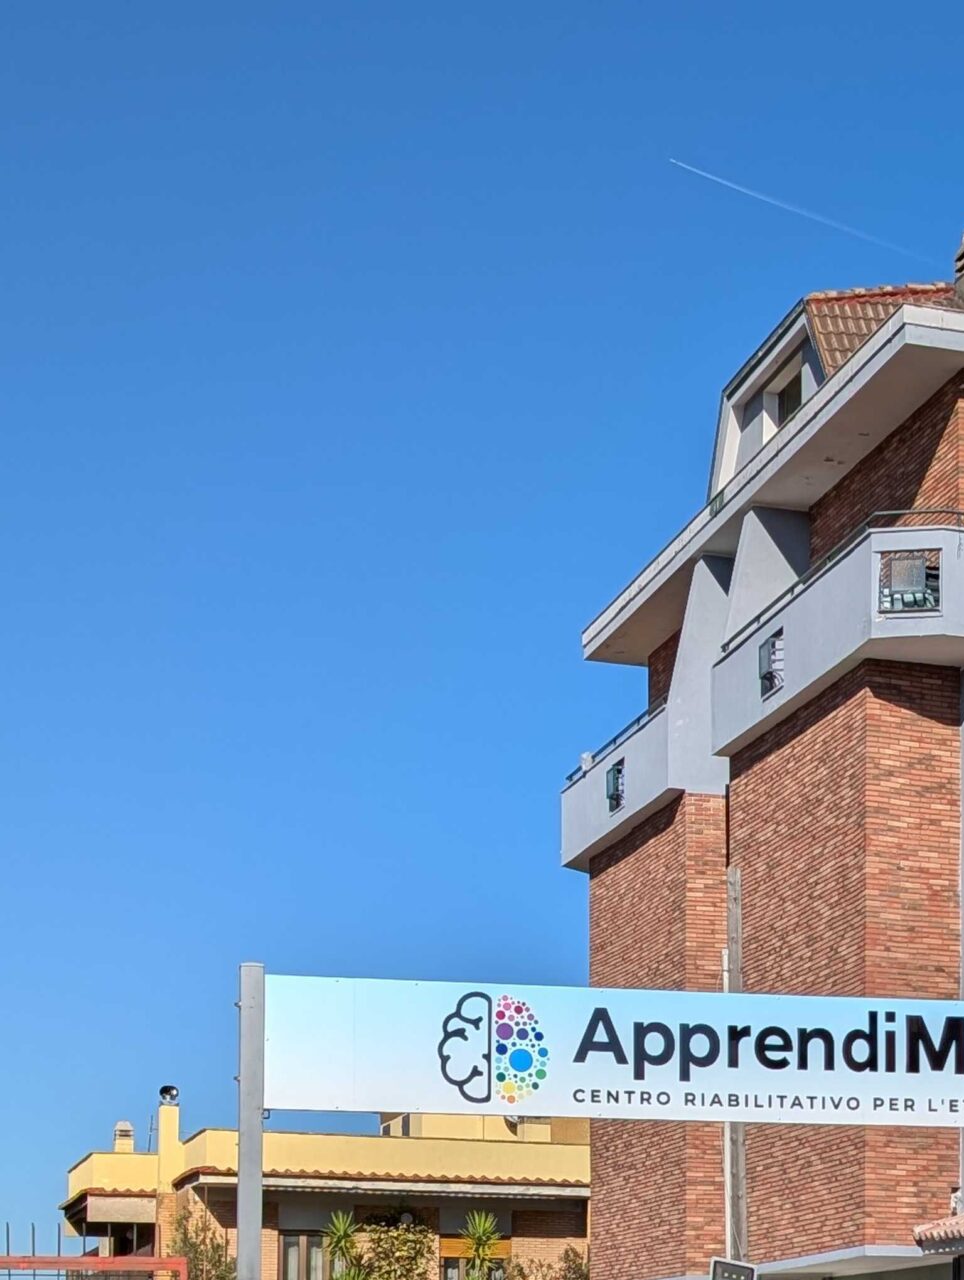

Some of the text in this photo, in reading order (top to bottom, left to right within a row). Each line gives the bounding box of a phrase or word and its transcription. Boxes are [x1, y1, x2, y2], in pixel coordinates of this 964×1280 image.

[572, 1087, 671, 1106] CENTRO
[684, 1091, 860, 1111] RIABILITATIVO
[873, 1096, 915, 1112] PER
